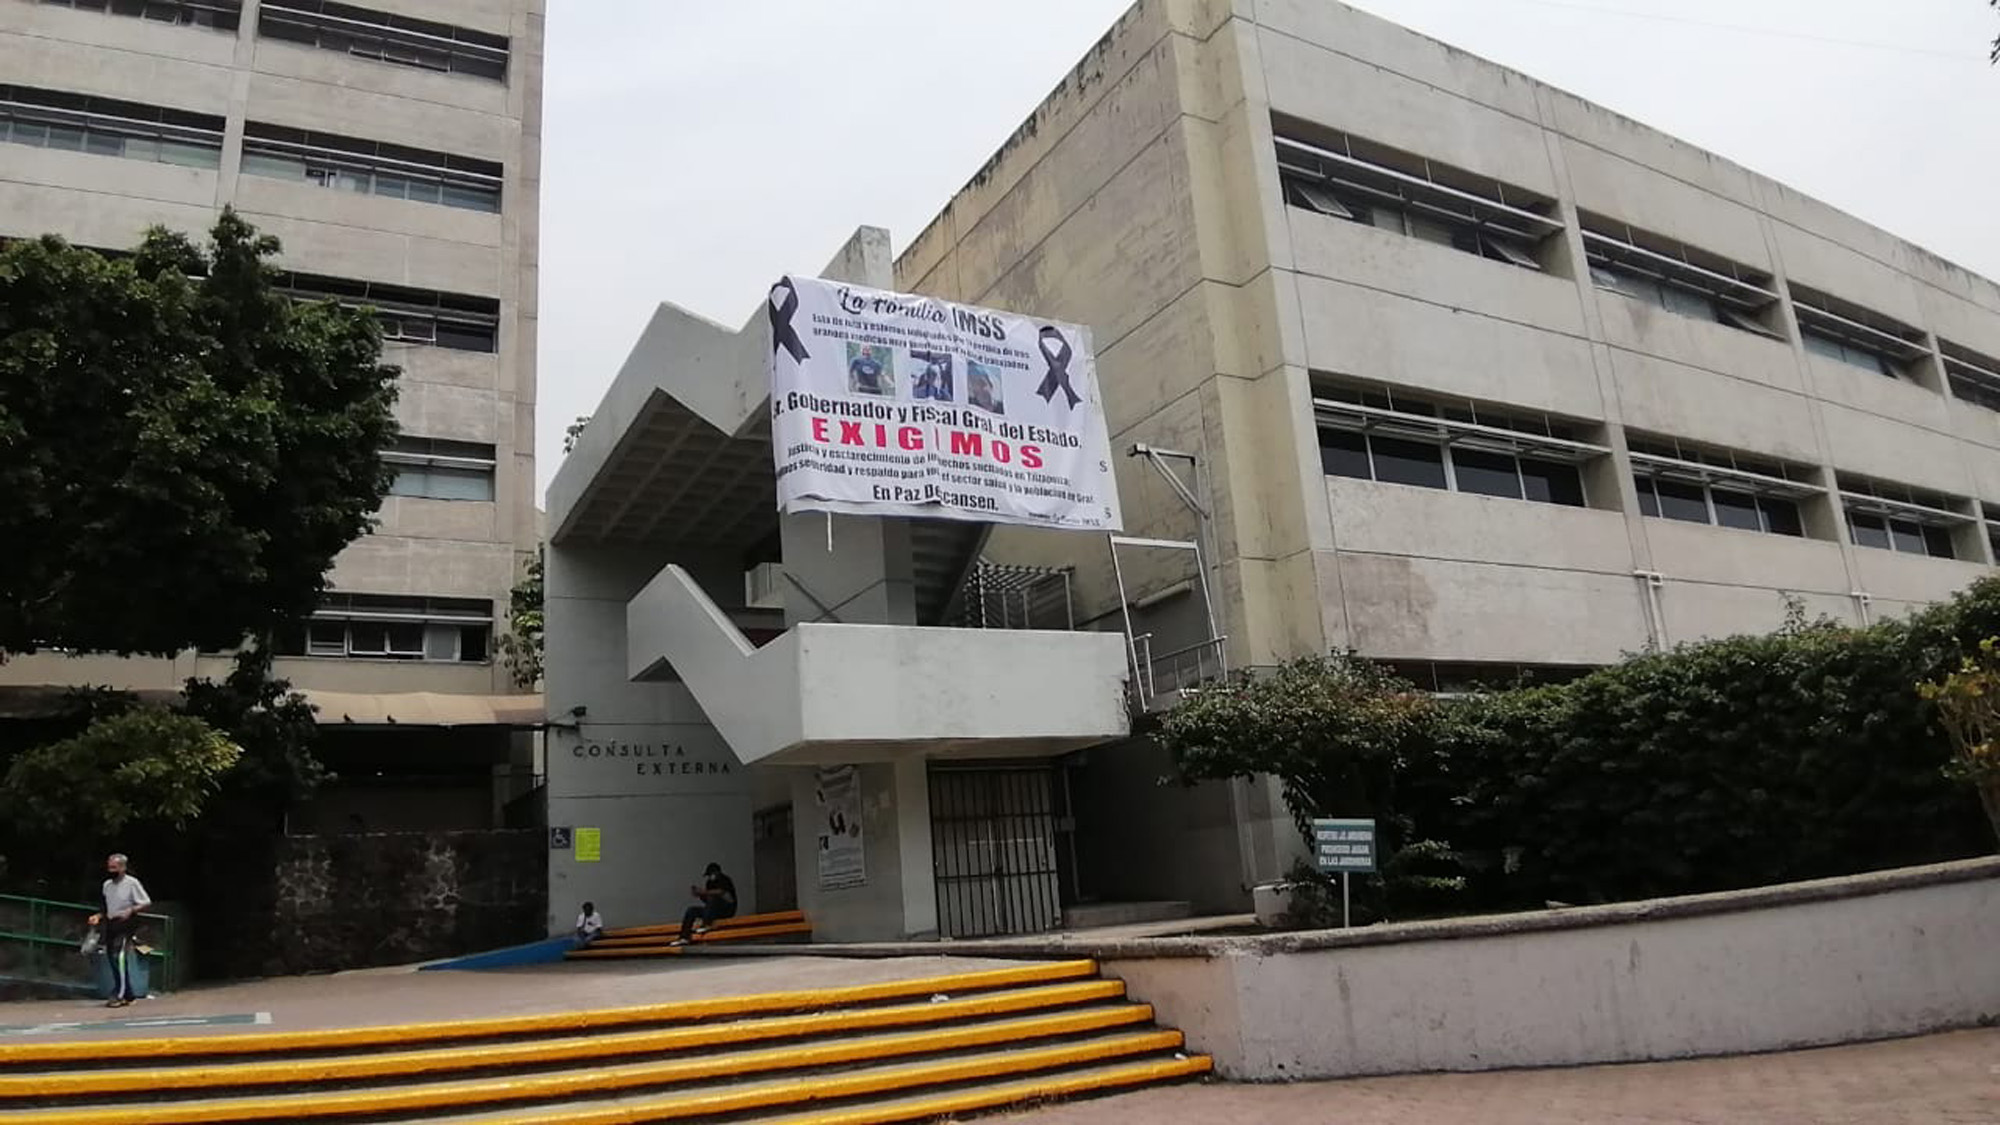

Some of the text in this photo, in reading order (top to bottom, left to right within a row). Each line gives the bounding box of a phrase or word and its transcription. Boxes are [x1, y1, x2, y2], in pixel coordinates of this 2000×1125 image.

[837, 286, 867, 315] La
[952, 306, 1006, 341] IMSS
[788, 391, 894, 420] Gobernador
[898, 406, 907, 423] y
[1000, 421, 1024, 441] del
[822, 449, 827, 459] y
[855, 466, 899, 478] respaldo
[901, 469, 924, 480] para
[951, 474, 982, 486] sector
[873, 484, 891, 501] En
[895, 485, 921, 501] Paz
[572, 743, 686, 758] CONSULTA
[636, 761, 731, 776] EXTERNA
